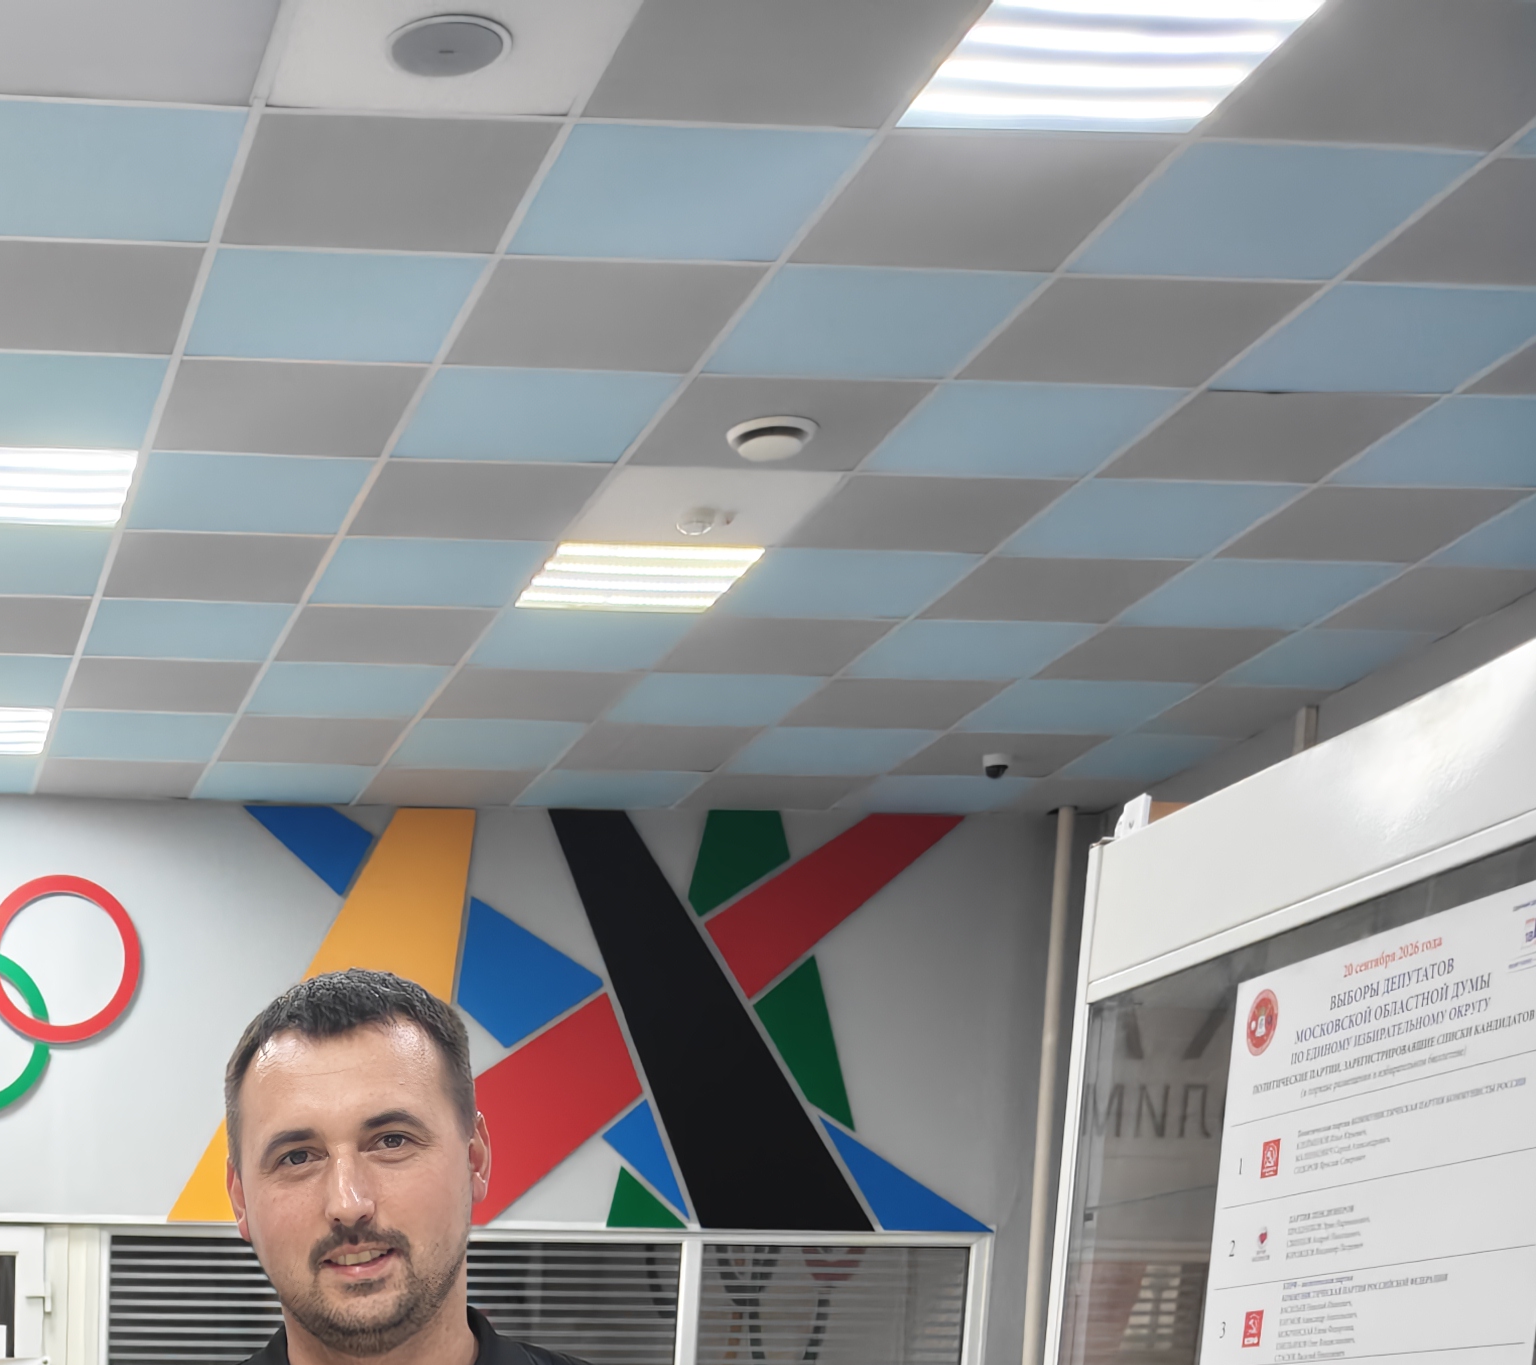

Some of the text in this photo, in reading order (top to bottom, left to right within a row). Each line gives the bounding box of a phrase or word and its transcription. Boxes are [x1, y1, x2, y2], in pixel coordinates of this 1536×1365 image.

[1329, 957, 1455, 1010] ВЫБОРЫ ДЕПУТАТОВ
[1343, 937, 1443, 978] 20 сентября 2026 года
[1290, 997, 1491, 1066] ПО ЕДИНОМУ ИЗБИРАТЕЛЬНОМУ ОКРУГУ
[1294, 972, 1492, 1044] МОСКОВСКОЙ ОБЛАСТНОЙ ДУМЫ
[1252, 1070, 1309, 1095] ПОЛИТИЧЕСКИЕ
[1343, 1036, 1436, 1071] ЗАРЕГИСТРИРОВАВШИЕ
[1436, 1026, 1473, 1046] СПИСКИ
[1473, 1009, 1535, 1036] КАНДИДАТОВ
[1228, 1239, 1236, 1258] 2
[1219, 1320, 1227, 1339] 3
